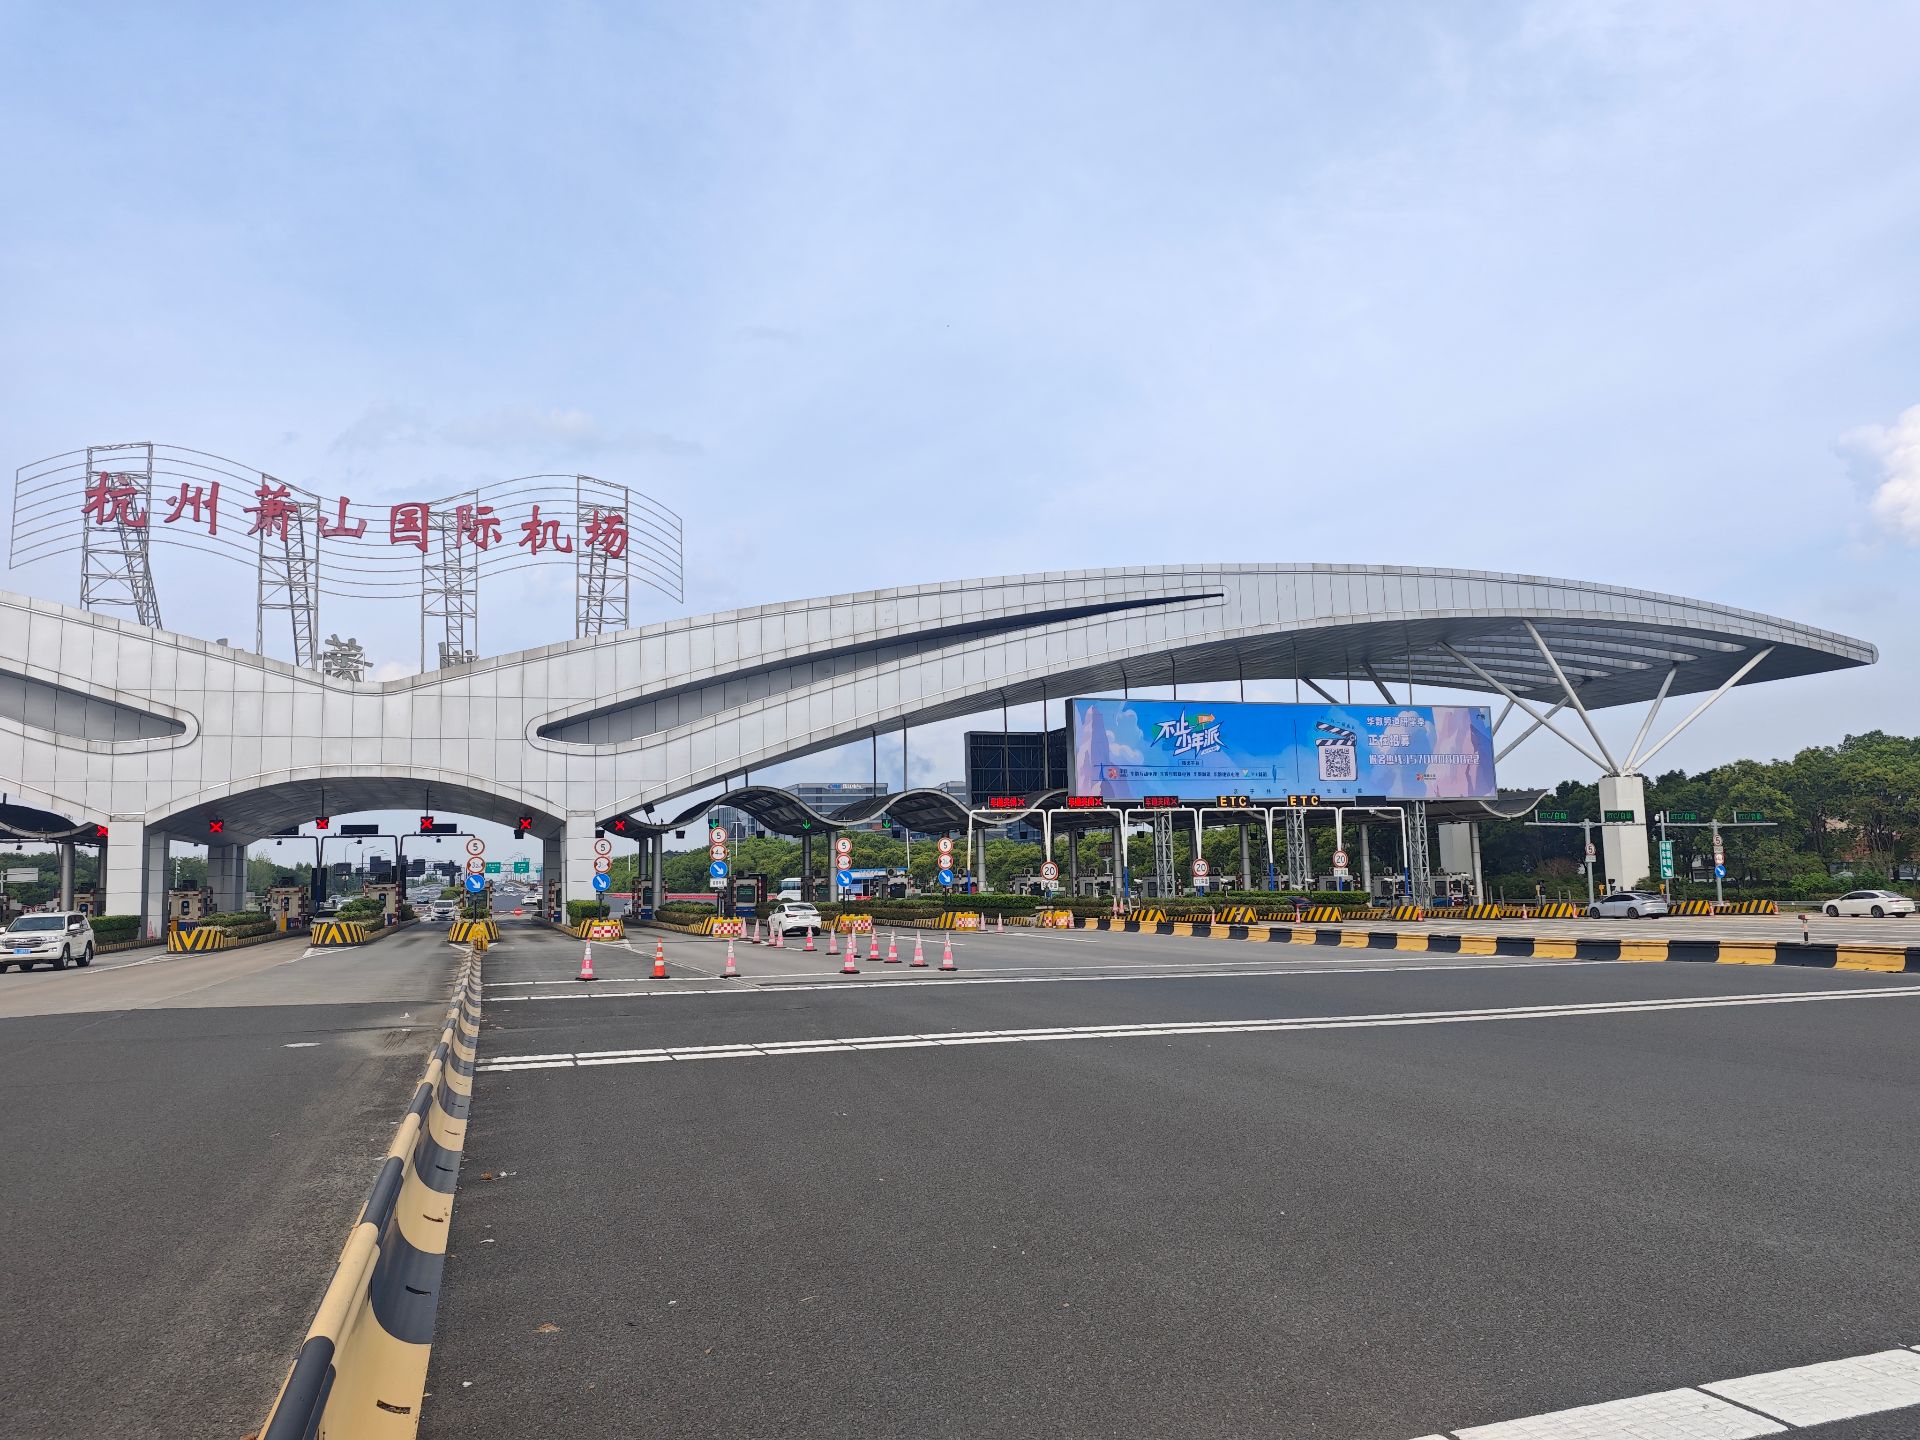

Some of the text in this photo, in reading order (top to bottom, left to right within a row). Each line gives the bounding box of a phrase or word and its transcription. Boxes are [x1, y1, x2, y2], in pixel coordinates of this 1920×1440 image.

[81, 471, 629, 559] 杭州萧山国际机场
[1220, 796, 1247, 807] ETC
[1290, 796, 1318, 807] ETC
[716, 832, 722, 840] 5
[1715, 836, 1720, 845] 5
[472, 842, 479, 852] 5
[600, 843, 606, 852] 5
[842, 842, 847, 850] 5
[943, 841, 948, 850] 5
[1588, 845, 1593, 854] 5
[1336, 855, 1346, 864] 20
[1045, 866, 1055, 876] 20
[1196, 863, 1206, 872] 20
